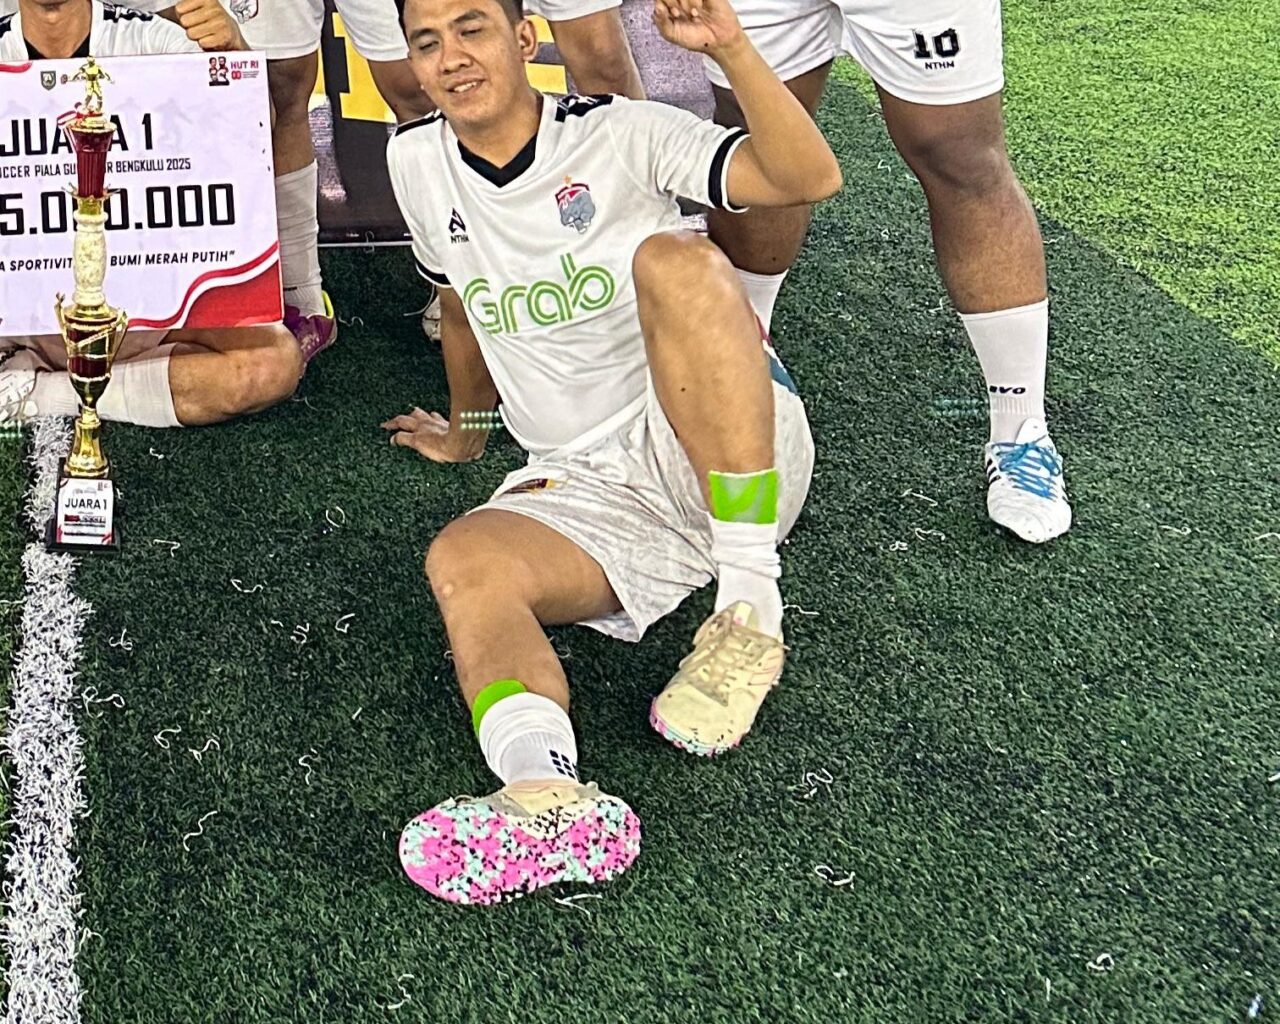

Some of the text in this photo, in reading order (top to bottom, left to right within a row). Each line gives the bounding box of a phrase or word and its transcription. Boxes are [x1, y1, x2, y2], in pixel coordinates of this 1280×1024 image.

[912, 28, 960, 59] 10
[141, 113, 153, 150] 1
[35, 163, 62, 176] PIALA
[116, 159, 164, 173] BENGKULU
[166, 158, 192, 171] 2025
[0, 183, 235, 236] 5.00.000
[110, 256, 141, 267] BUMI
[145, 253, 188, 265] MERAH
[464, 252, 615, 334] Grab
[64, 498, 101, 510] JUARA
